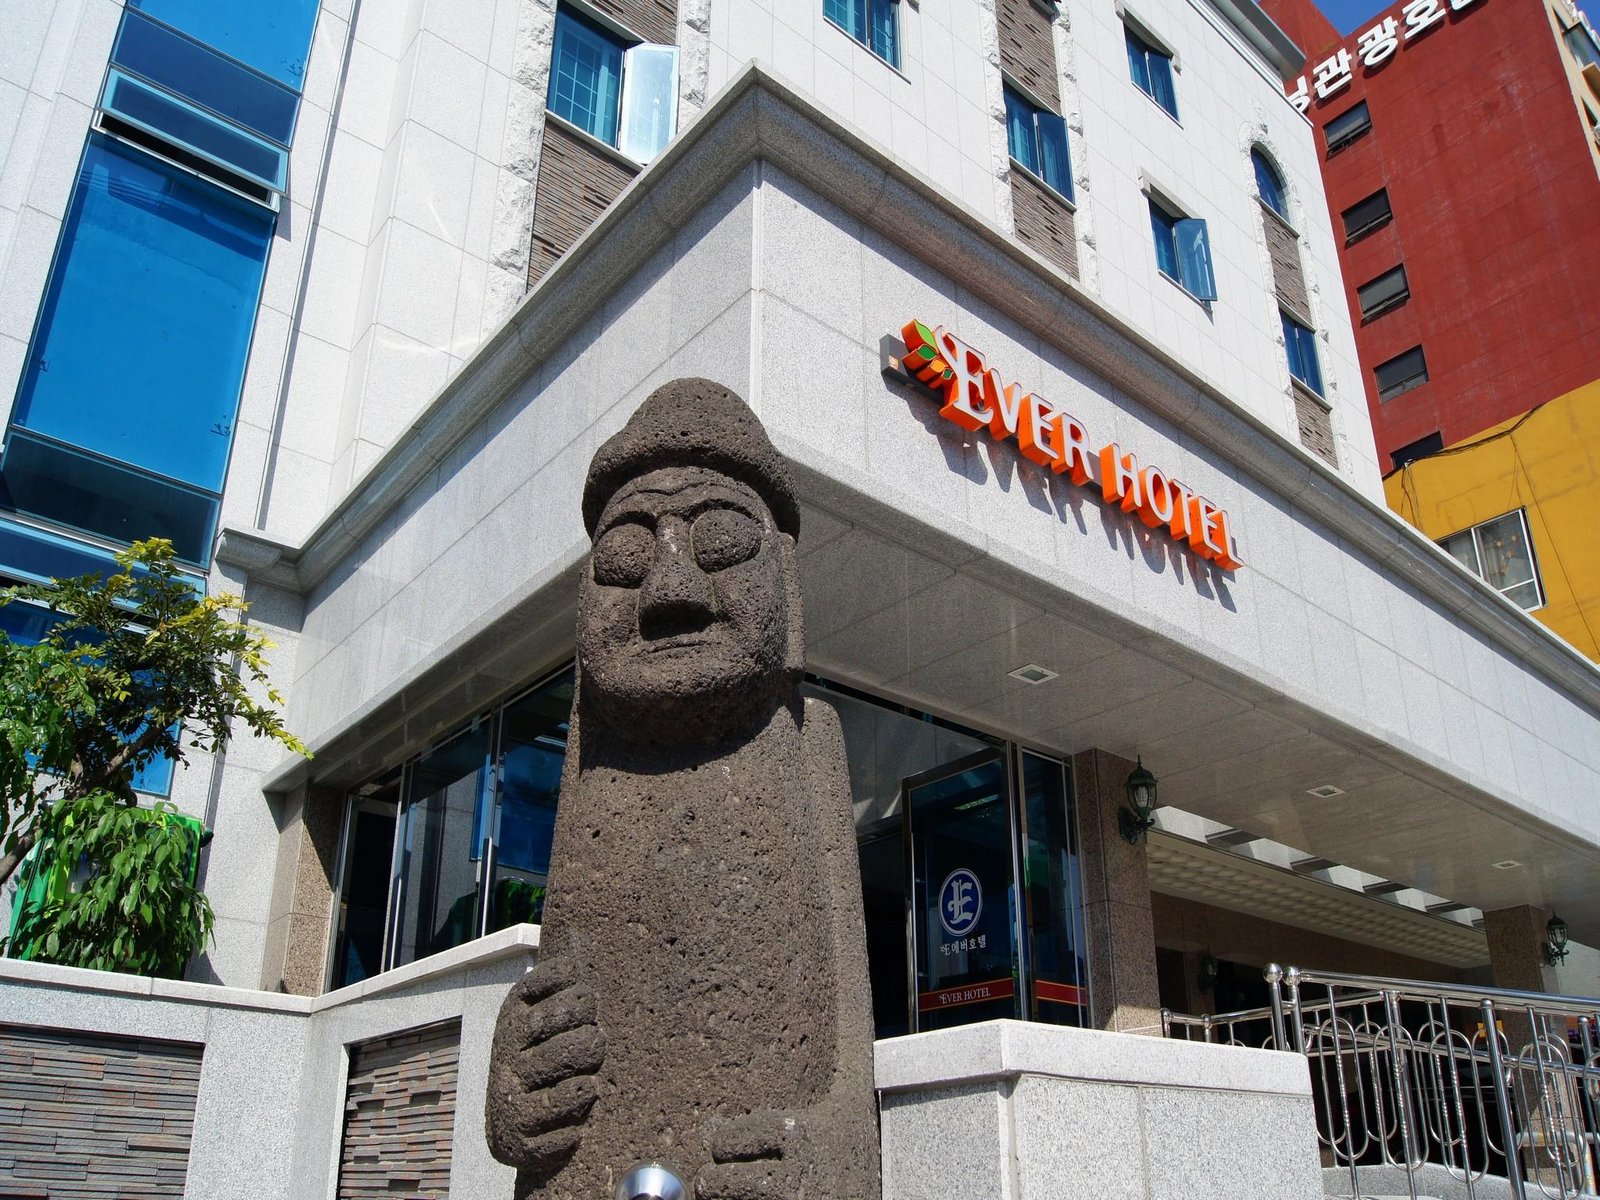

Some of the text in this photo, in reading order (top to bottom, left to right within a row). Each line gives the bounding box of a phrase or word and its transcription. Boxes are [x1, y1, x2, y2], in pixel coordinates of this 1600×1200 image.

[935, 325, 1244, 571] EVER HOTEL
[939, 987, 991, 1004] EVER HOTEL
